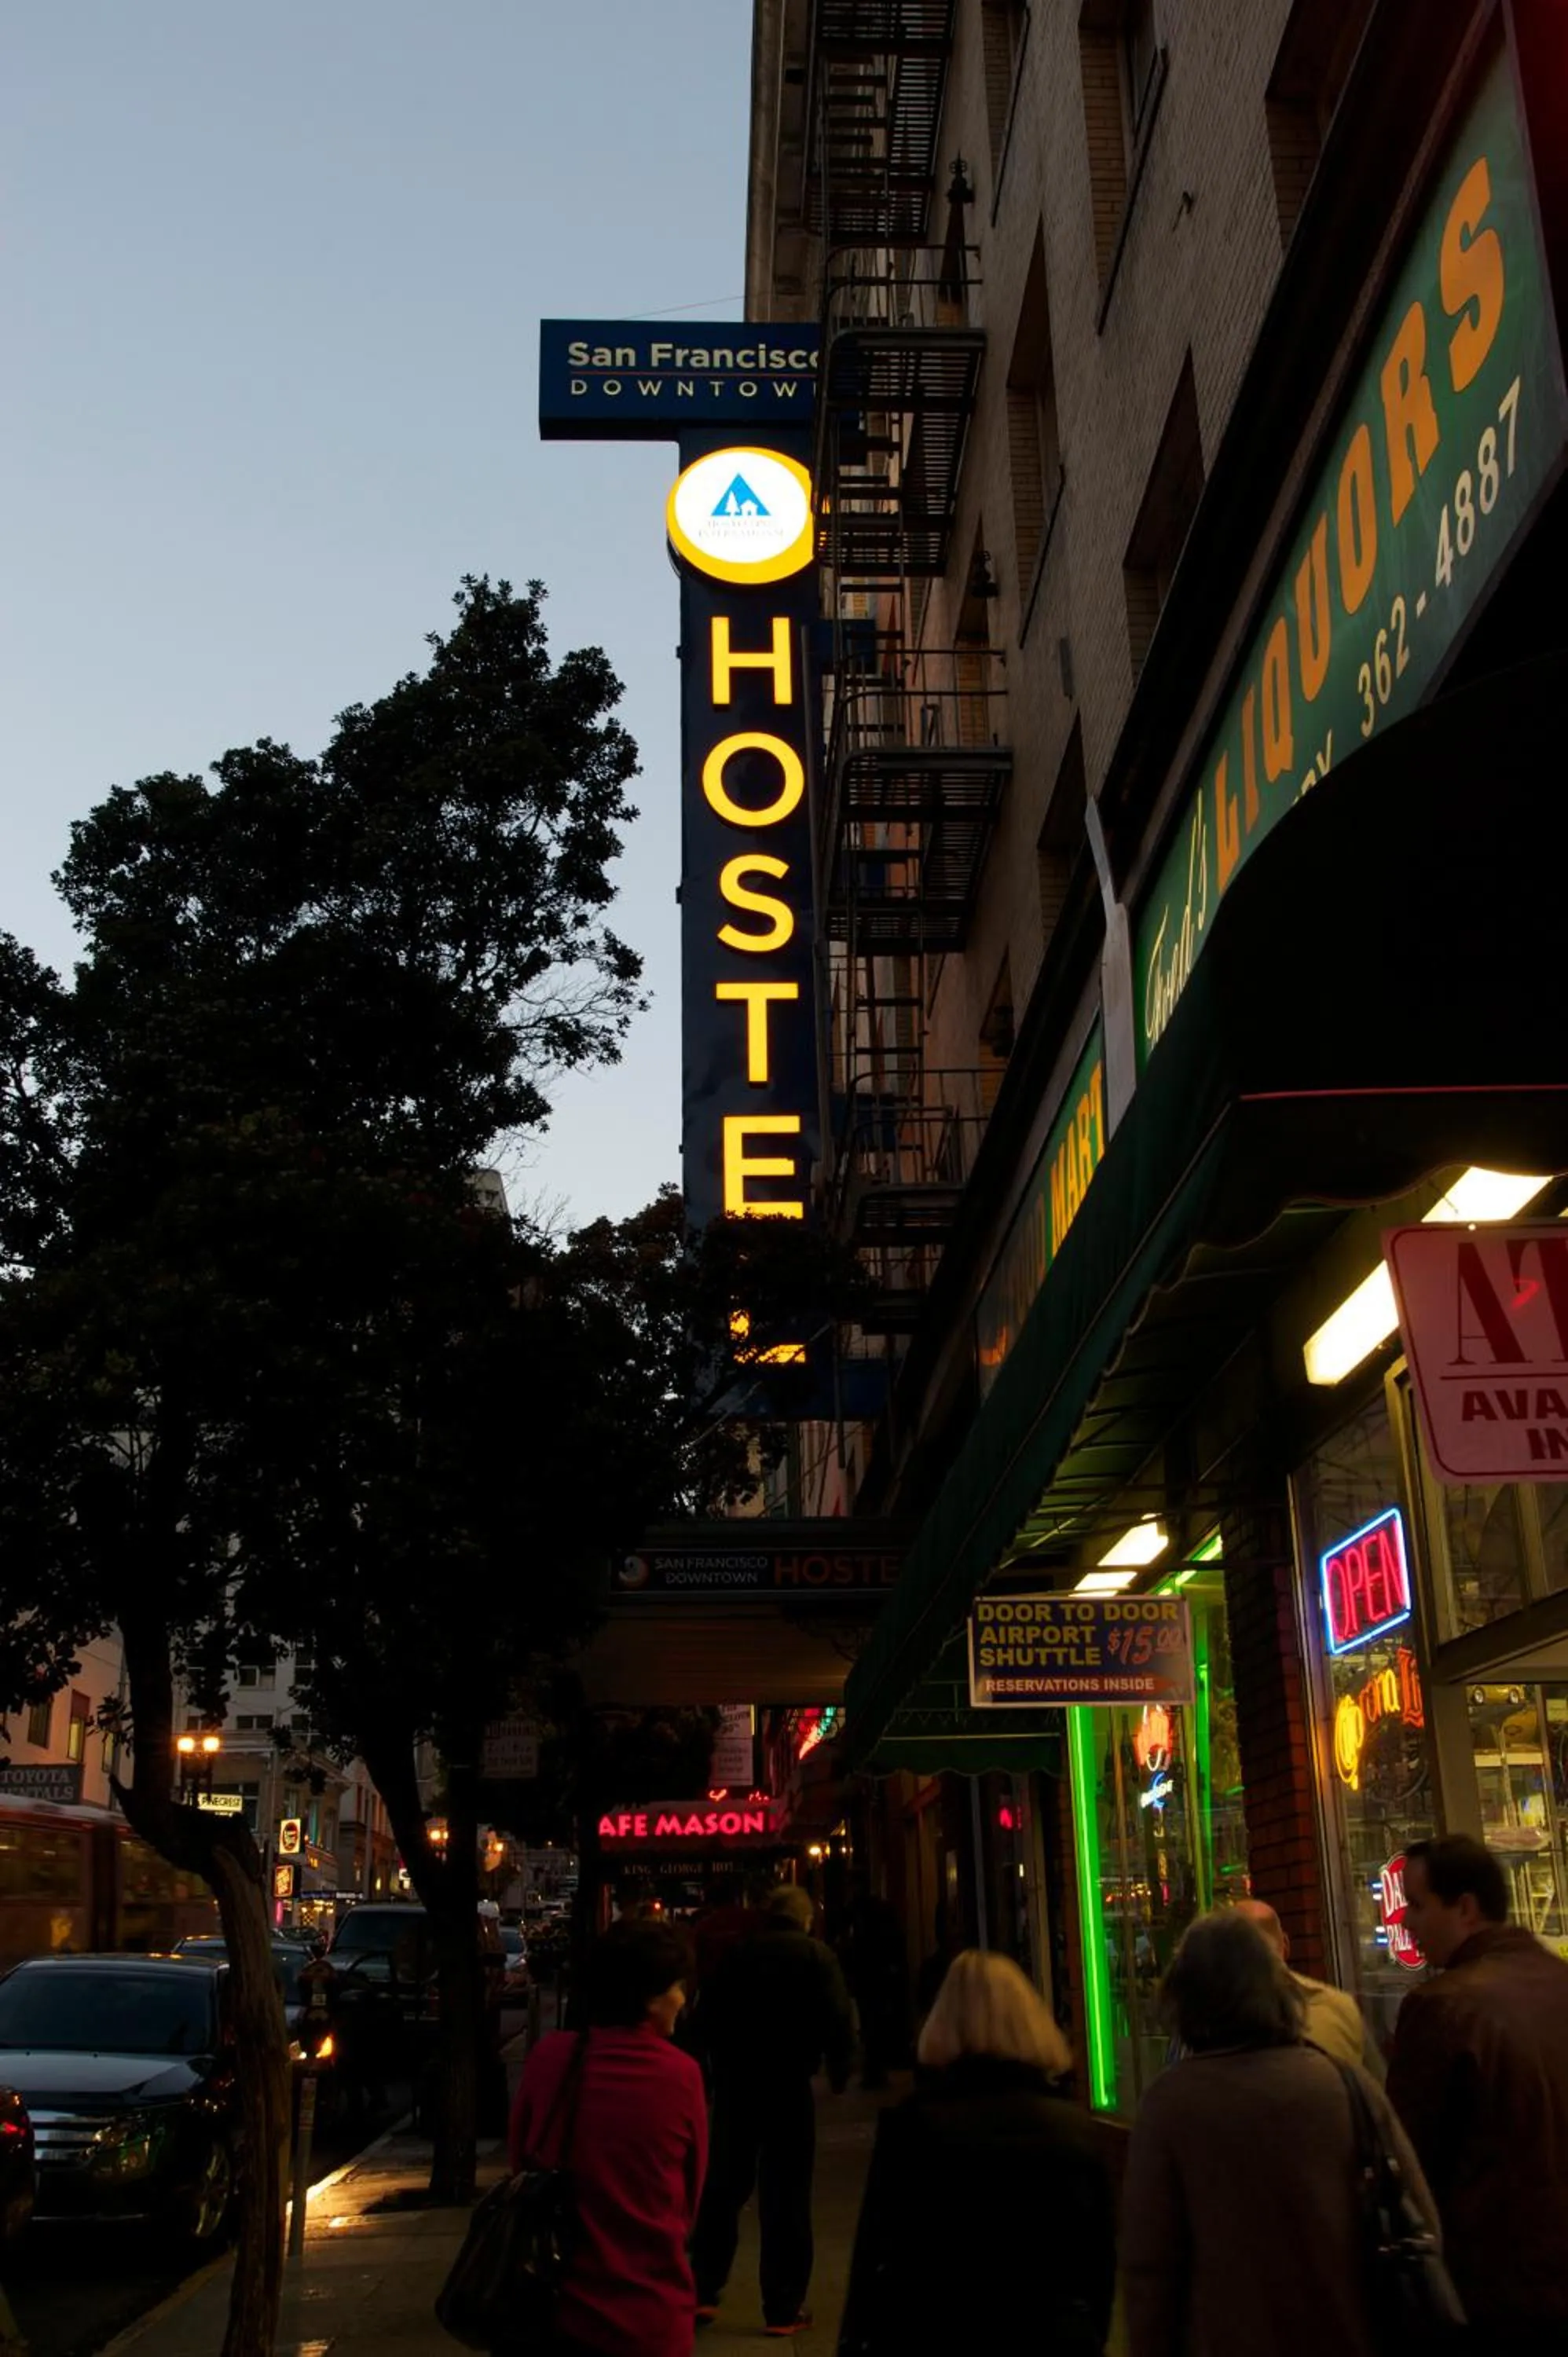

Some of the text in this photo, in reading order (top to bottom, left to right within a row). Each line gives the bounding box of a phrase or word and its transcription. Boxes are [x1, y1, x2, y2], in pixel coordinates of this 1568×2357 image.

[567, 341, 636, 368] San
[571, 379, 817, 398] DOWNTOW
[1214, 156, 1504, 895] LIQUORS
[654, 1557, 684, 1570] SAN
[686, 1556, 768, 1570] FRANCISCO
[665, 1572, 759, 1585] DOWNTOWN
[1328, 1520, 1405, 1644] OPEN
[977, 1602, 1178, 1622] DOOR TO DOOR
[980, 1625, 1097, 1645] AIRPORT
[980, 1647, 1101, 1667] SHUTTLE
[986, 1677, 1155, 1692] RESERVATIONS INSIDE
[0, 1769, 71, 1783] TOYOTA
[654, 1809, 766, 1837] MASON
